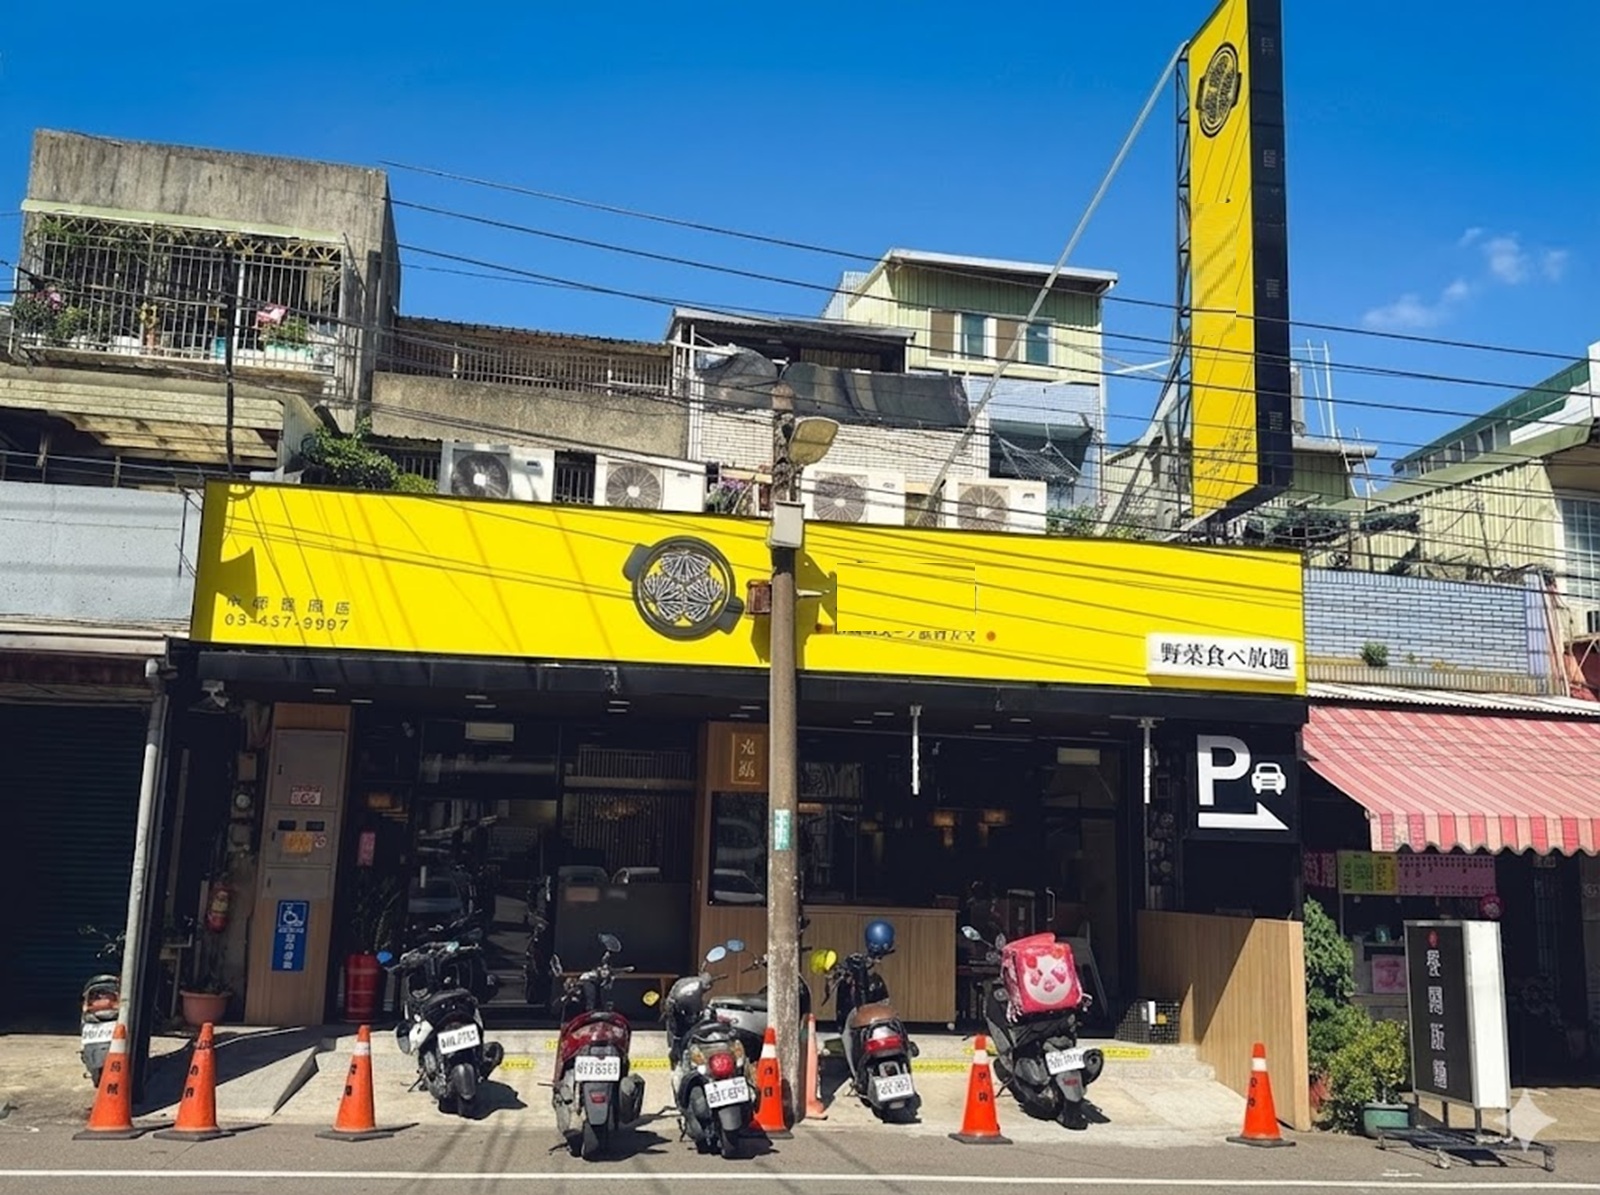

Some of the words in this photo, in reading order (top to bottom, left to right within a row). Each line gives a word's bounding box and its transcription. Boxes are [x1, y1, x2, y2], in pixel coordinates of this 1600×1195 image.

[1161, 642, 1290, 670] 野菜食べ放題
[1197, 735, 1251, 806] P
